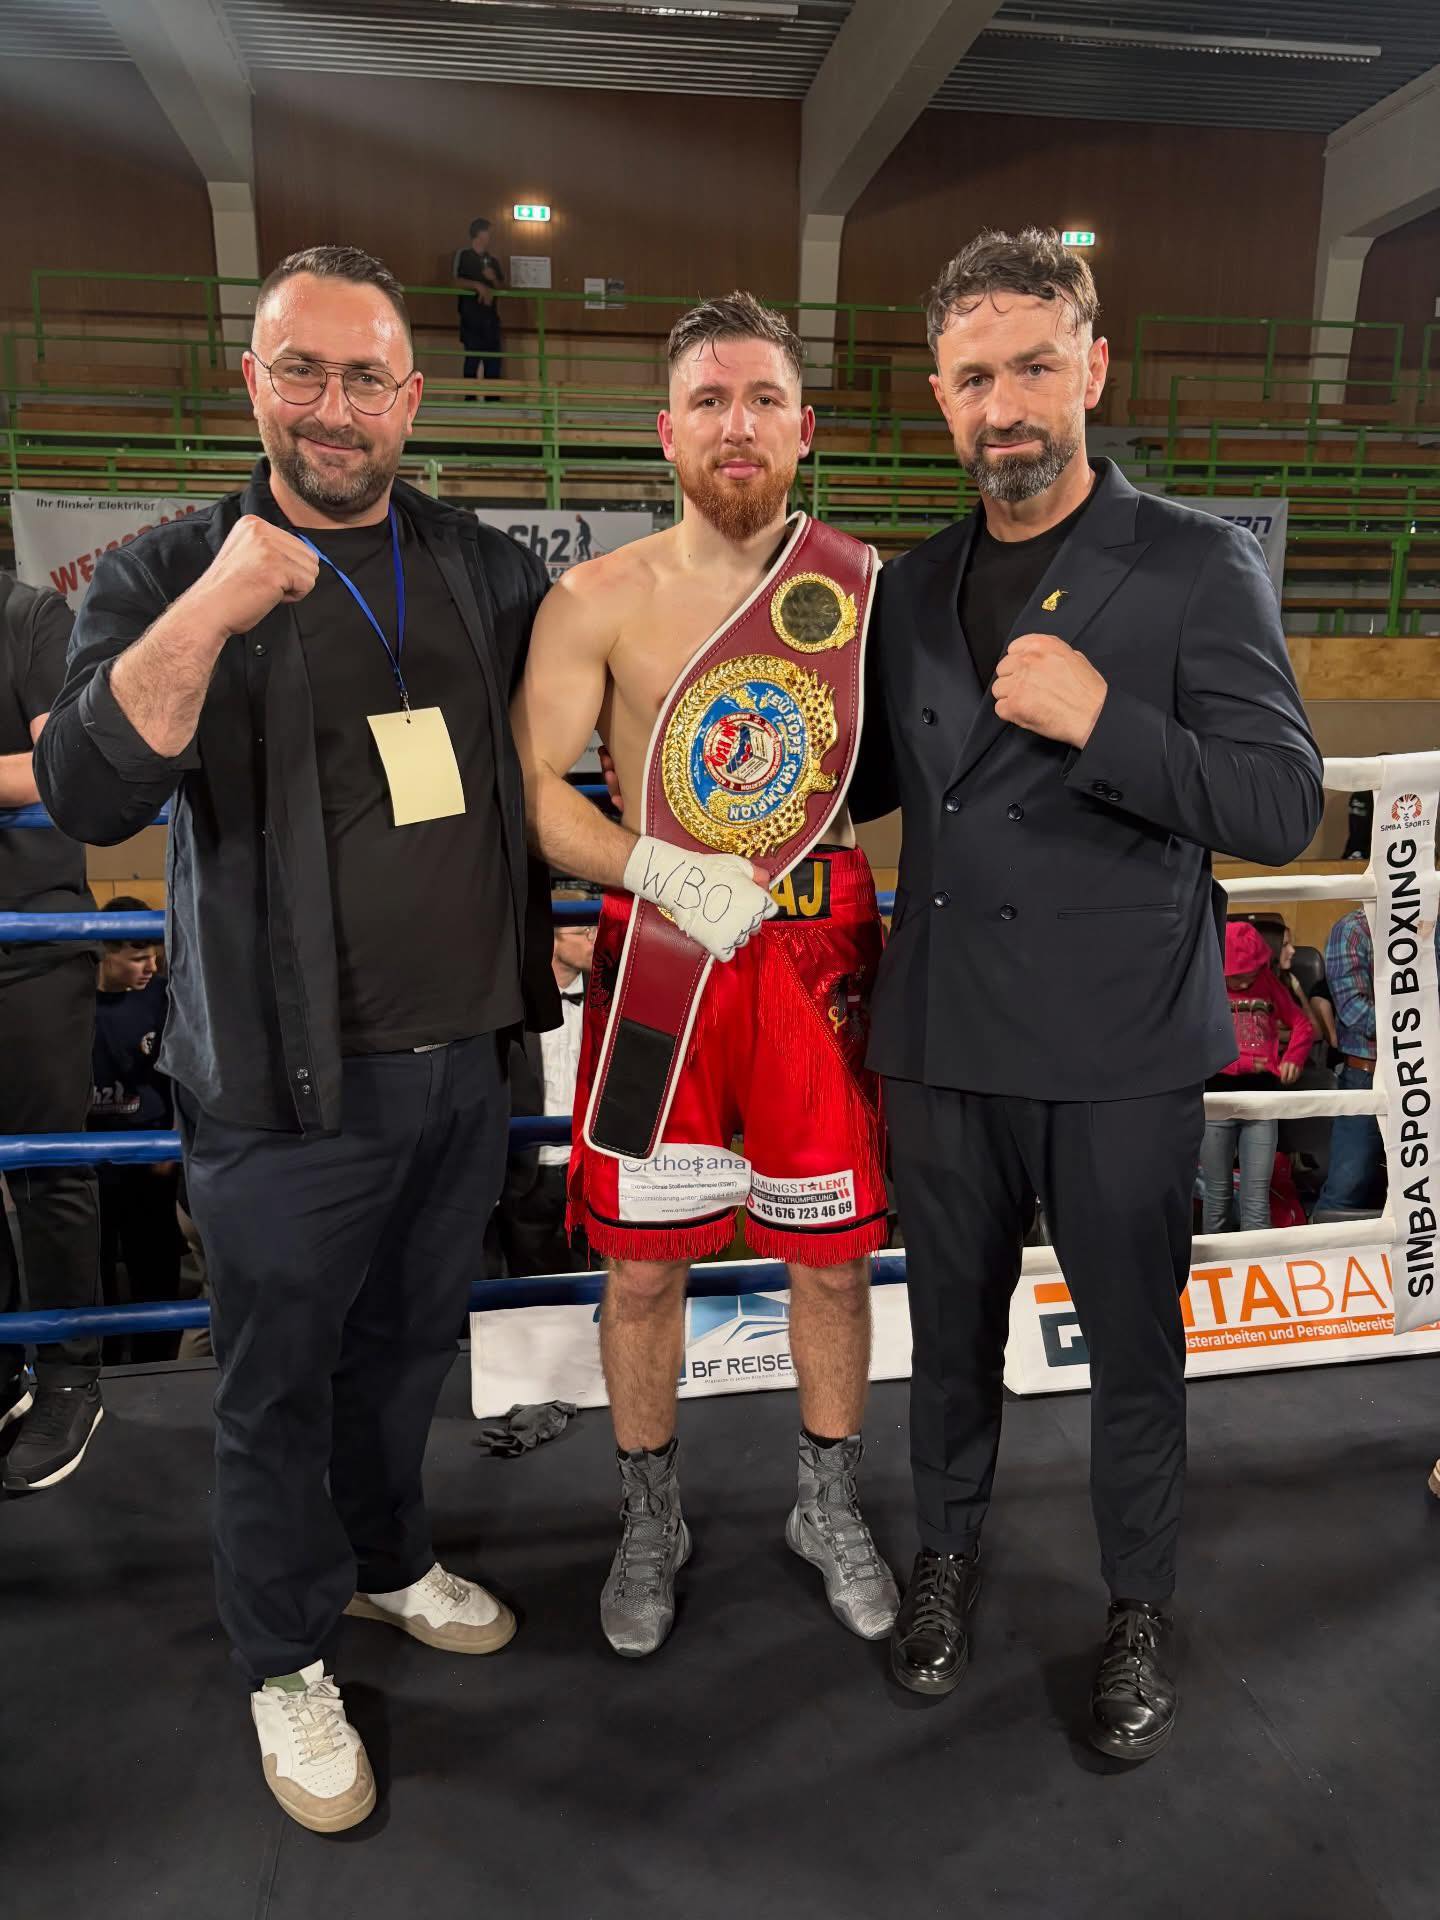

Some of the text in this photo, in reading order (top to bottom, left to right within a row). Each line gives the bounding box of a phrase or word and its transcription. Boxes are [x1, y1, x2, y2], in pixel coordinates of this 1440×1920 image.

[36, 498, 156, 511] Ihr flinker Elektriker
[729, 760, 798, 820] CHAMPION
[1380, 819, 1430, 832] SIMBA SPORTS
[642, 846, 732, 924] WBO
[1387, 838, 1436, 1298] SIMBA SPORTS BOXING
[757, 1200, 852, 1219] +43 676 723 46 69
[1270, 1326, 1295, 1341] und
[691, 1360, 722, 1378] BF
[727, 1353, 792, 1375] REISE
